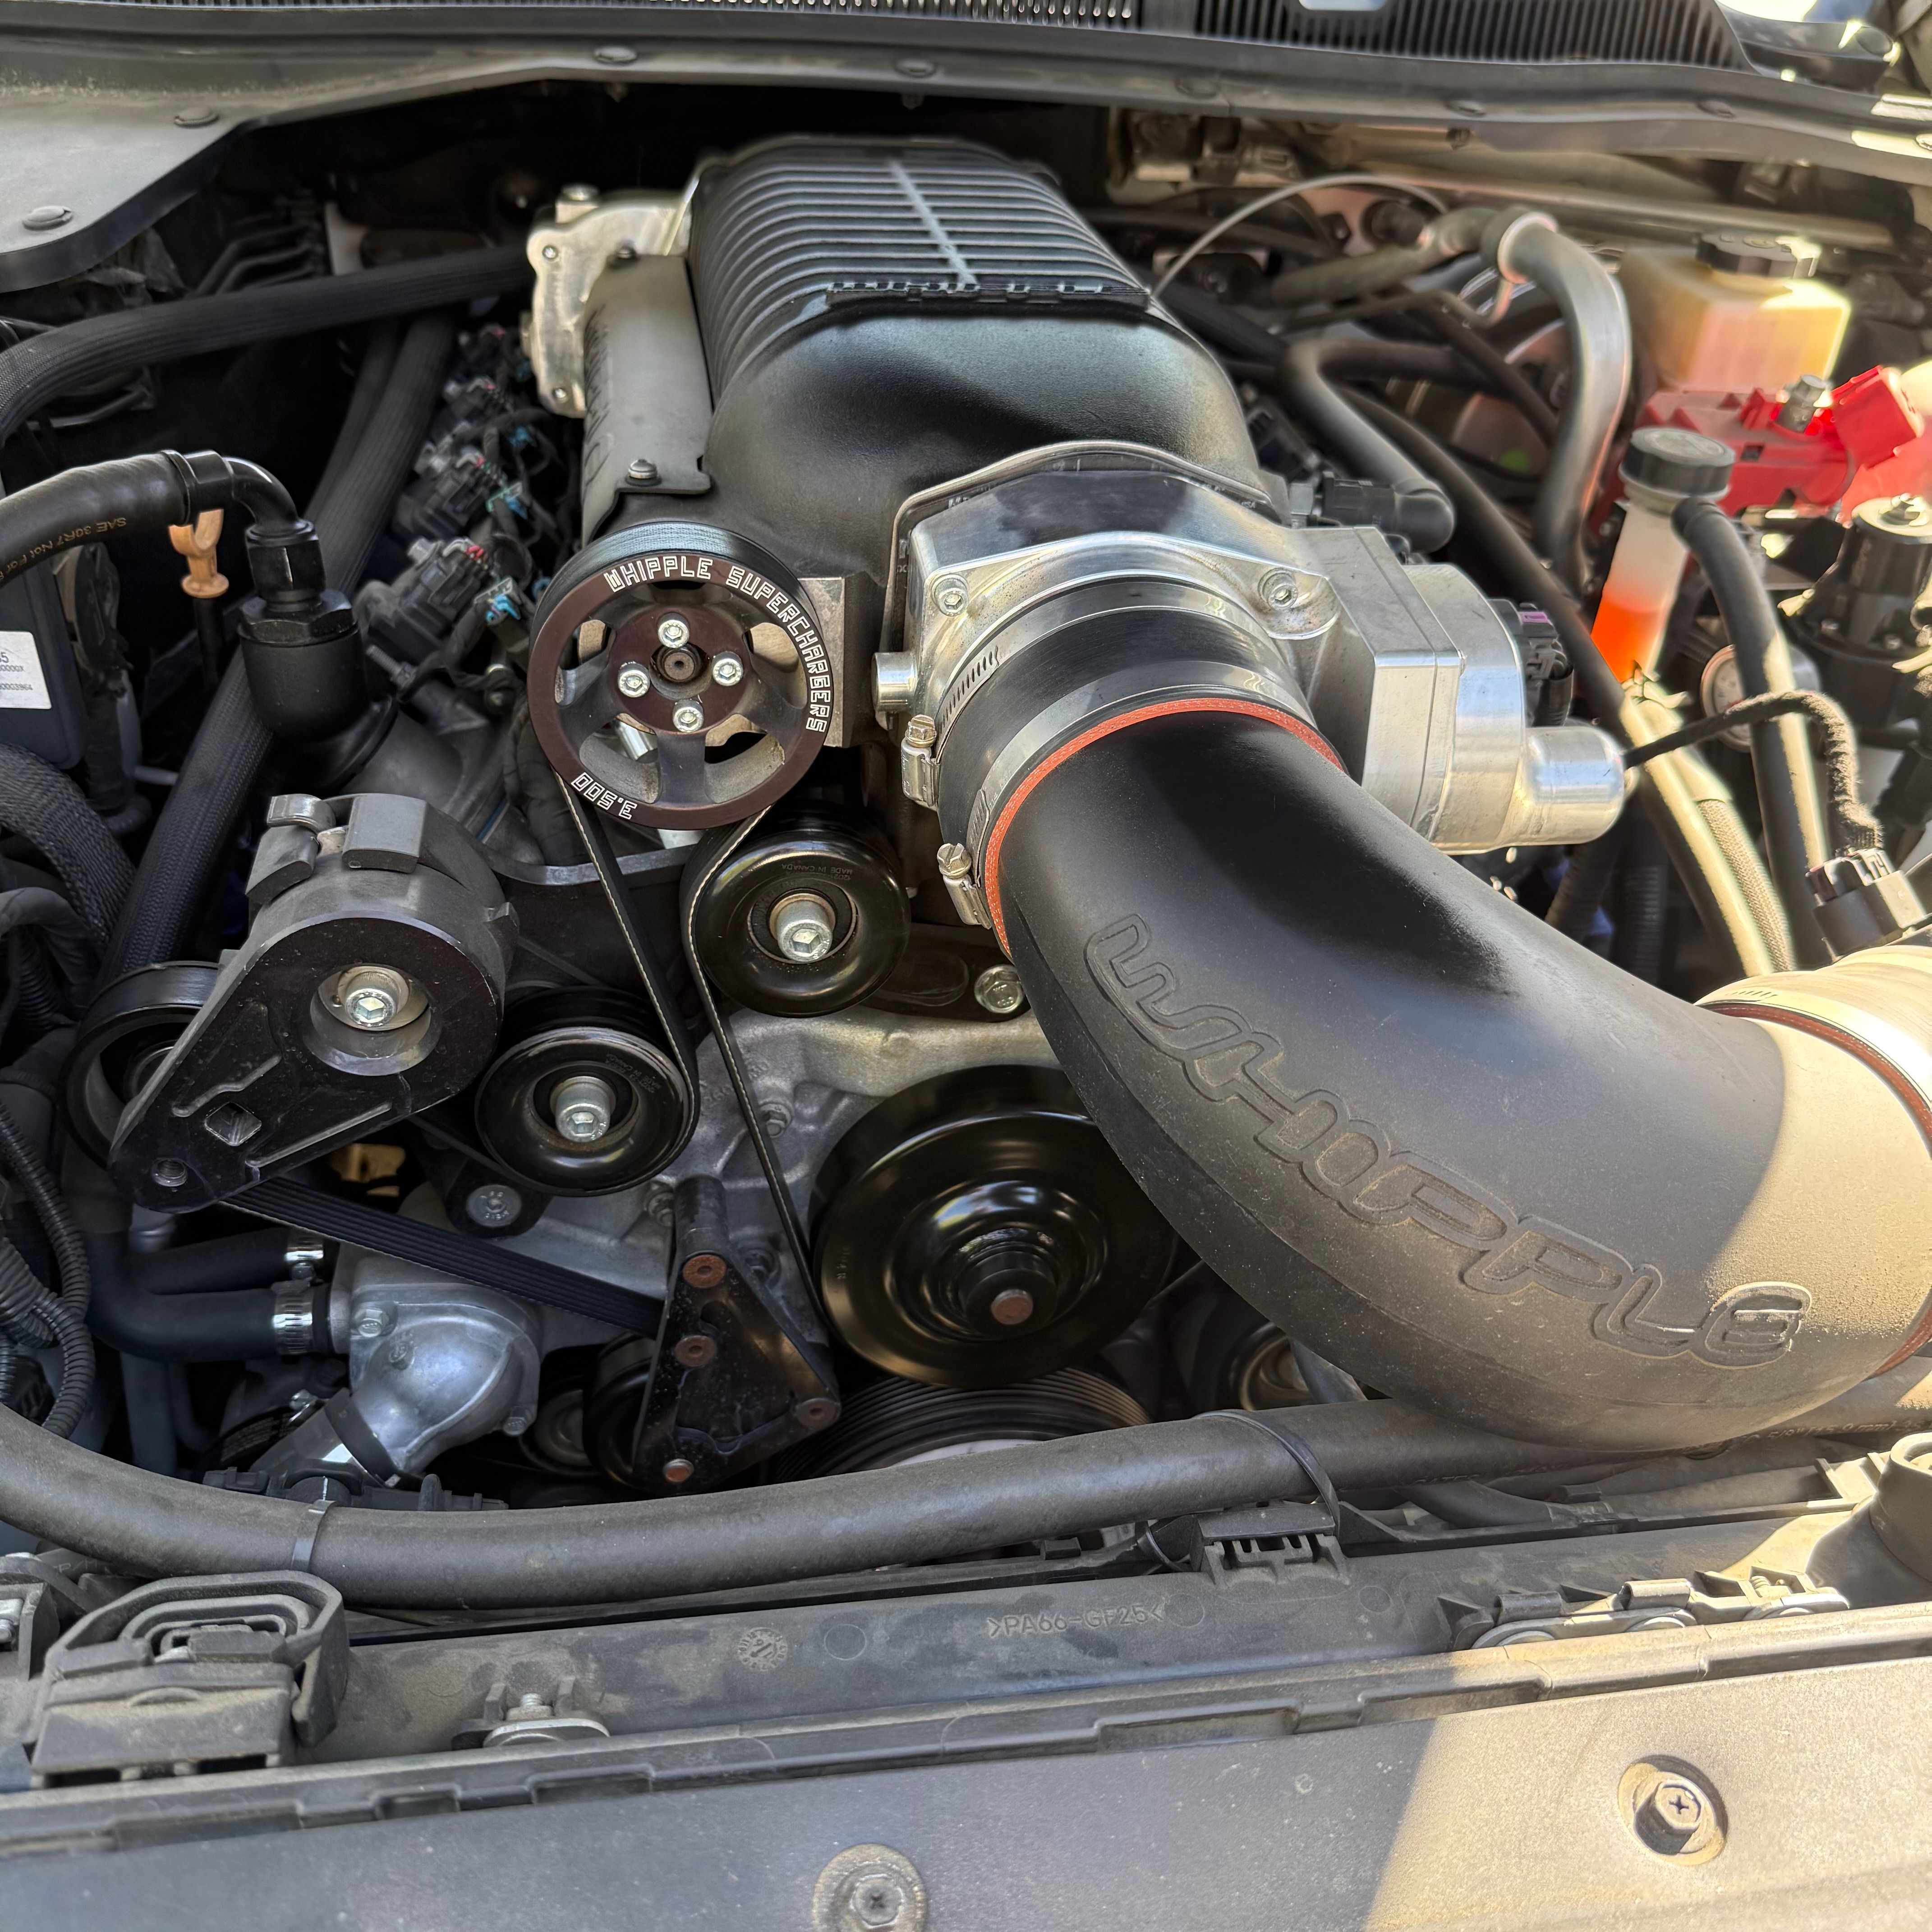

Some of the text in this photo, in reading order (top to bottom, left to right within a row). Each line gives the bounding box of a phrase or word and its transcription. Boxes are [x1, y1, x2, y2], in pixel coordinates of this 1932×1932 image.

[96, 517, 127, 532] SAE
[57, 526, 92, 546] 30R7
[30, 540, 53, 559] Not
[603, 556, 831, 733] WHIPPLE SUPERCHARGERS
[571, 772, 637, 820] 3.500
[782, 864, 815, 872] CANADA
[830, 867, 853, 875] MADE
[1083, 914, 1812, 1367] WHIPPLE
